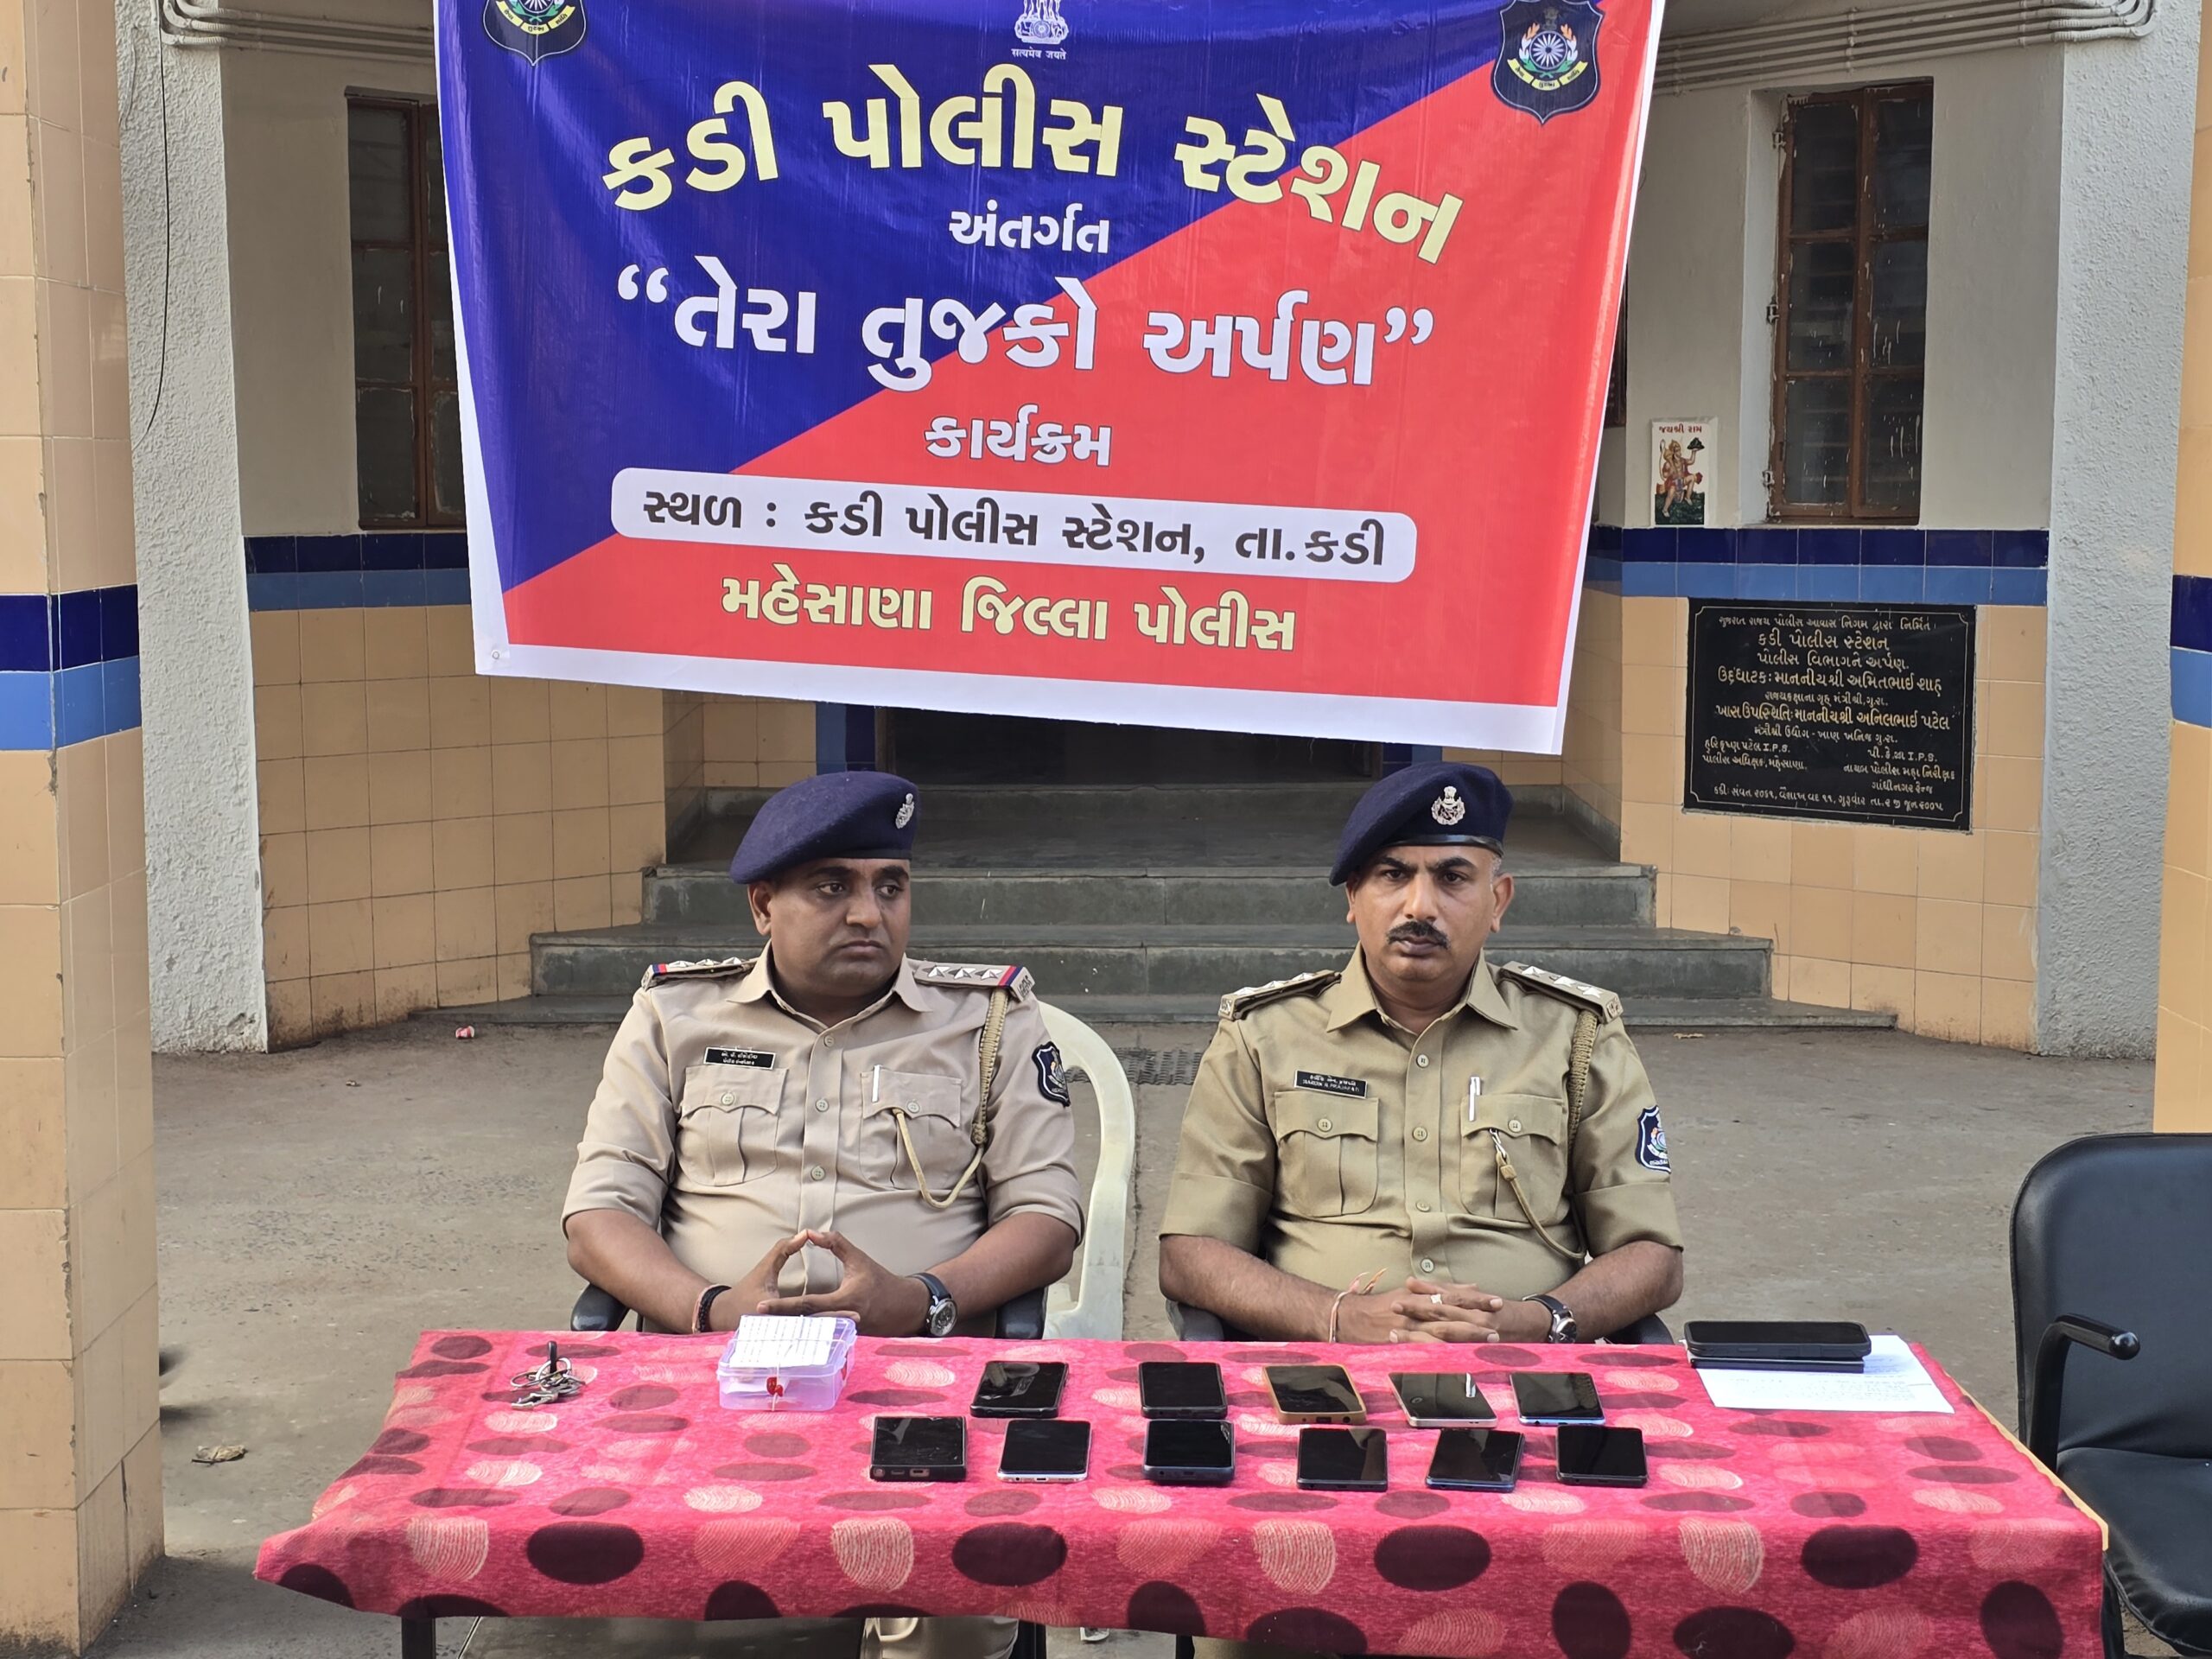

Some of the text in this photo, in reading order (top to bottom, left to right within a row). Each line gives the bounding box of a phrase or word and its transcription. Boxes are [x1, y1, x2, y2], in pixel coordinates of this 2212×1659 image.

[1011, 46, 1067, 60] सत्यमेव जयते
[602, 63, 1464, 264] કડી પોલીસ સ્ટેશન
[949, 199, 1110, 255] અંતર્ગત
[617, 256, 1434, 392] “તેરા તુજકો અર્પણ”
[924, 403, 1112, 467] કાર્યક્રમ
[643, 490, 742, 529] સ્થળ
[804, 490, 882, 537] કડી
[905, 493, 1039, 546] પોલીસ
[1062, 502, 1205, 564] સ્ટેશન,
[721, 563, 1296, 652] મહેસાણા જિલ્લા પોલીસ
[1774, 613, 1803, 627] પોલીસ
[1841, 615, 1868, 629] નિગમ
[1758, 627, 1890, 651] કડી પોલીસ સ્ટેશન
[1758, 648, 1800, 665] પોલીસ
[1808, 650, 1862, 668] વિભાગને
[1847, 671, 1915, 690] અમિતભાઈ
[1916, 677, 1942, 697] શાહ
[1856, 708, 1918, 728] અનિલભાઈ
[1921, 710, 1950, 730] પટેલ
[1870, 761, 1900, 776] પોલીસ
